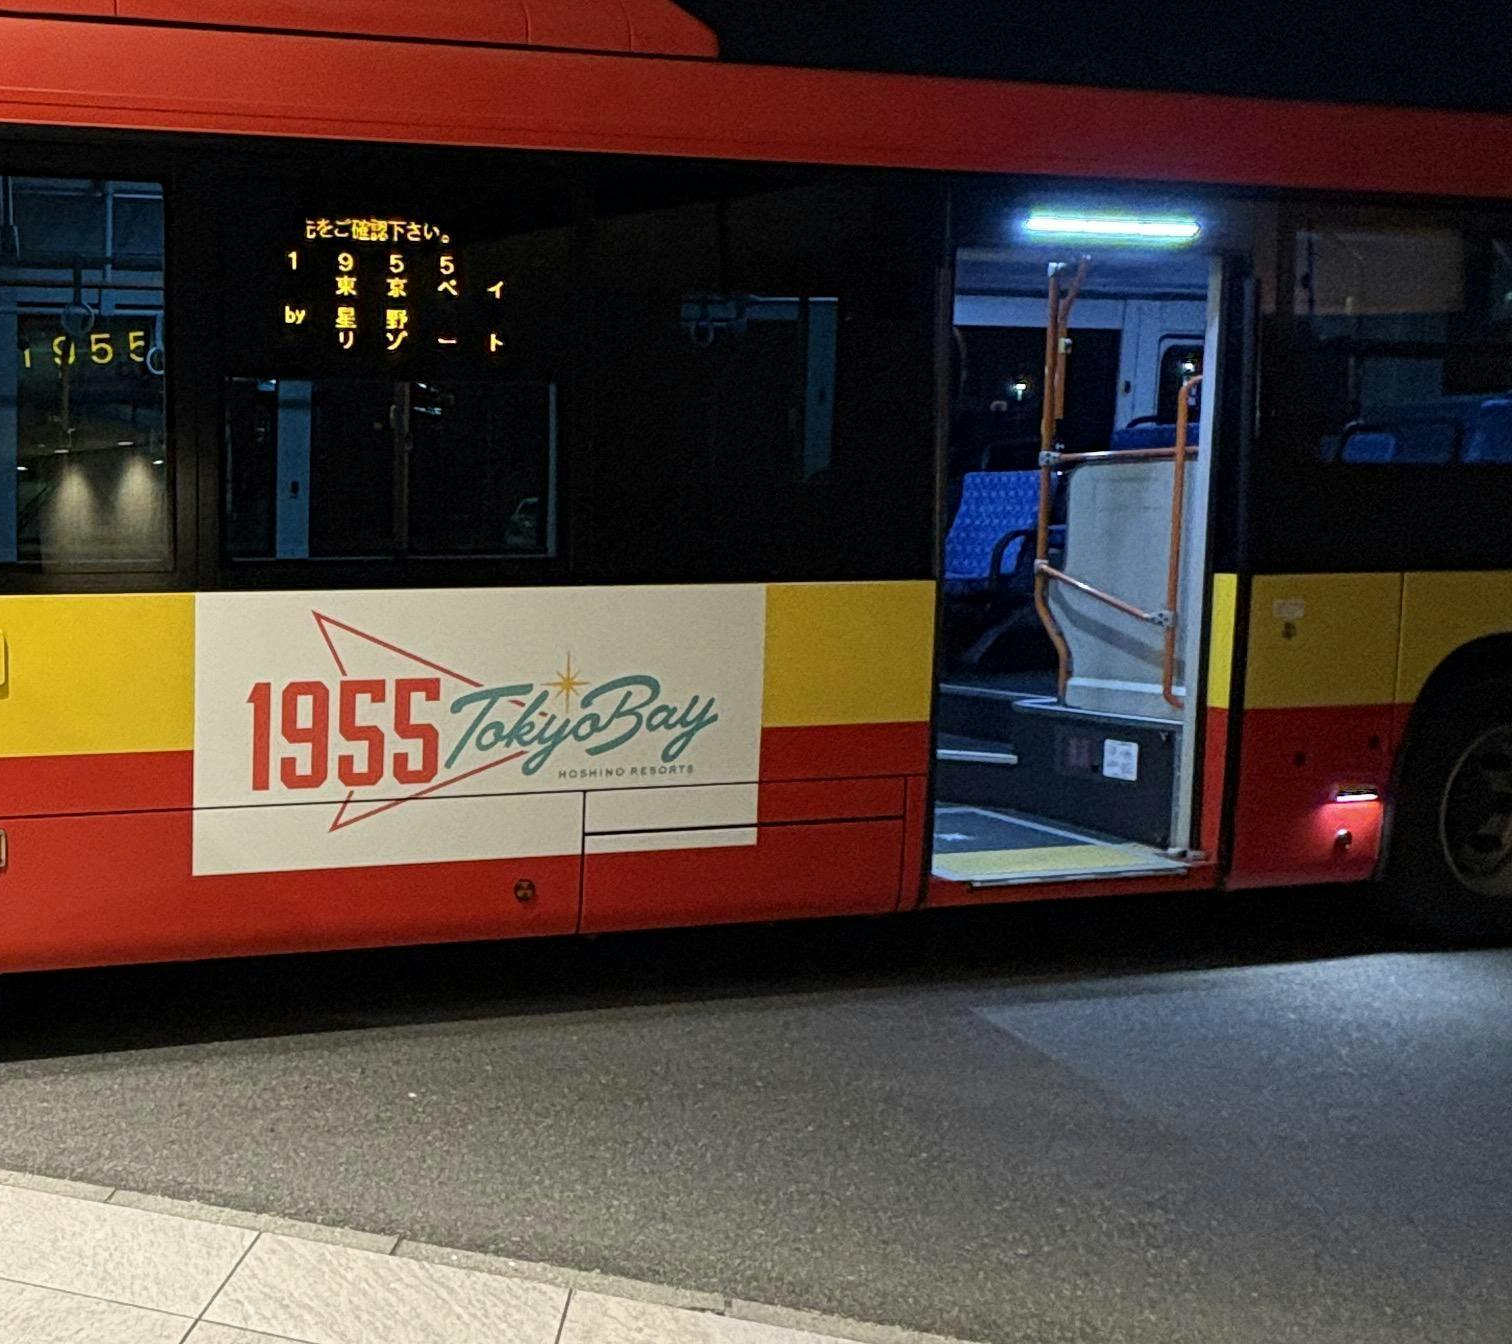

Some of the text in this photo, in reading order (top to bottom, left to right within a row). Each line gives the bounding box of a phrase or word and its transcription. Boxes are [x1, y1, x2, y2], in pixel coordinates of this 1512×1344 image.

[284, 305, 408, 329] by 星野
[339, 330, 505, 352] リゾート
[246, 674, 720, 791] 1955 Tokyo Bay
[558, 765, 694, 779] HOSHINO RESORTS
